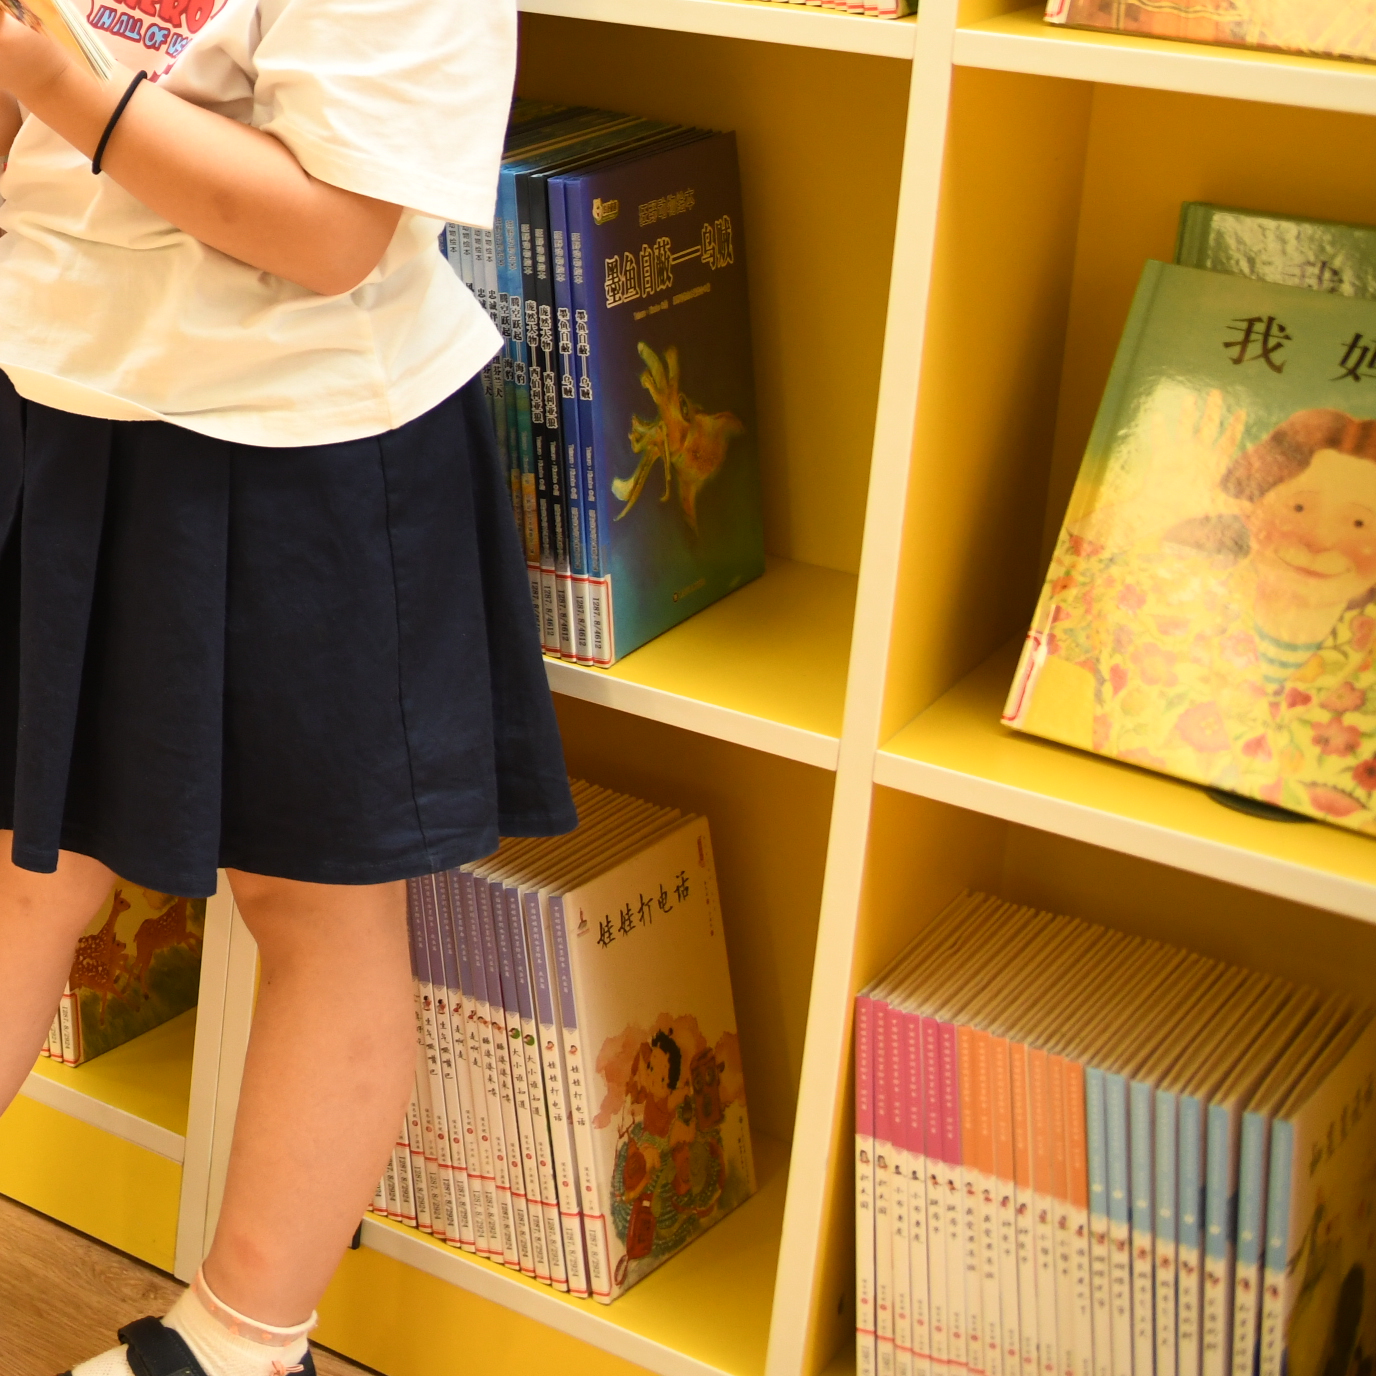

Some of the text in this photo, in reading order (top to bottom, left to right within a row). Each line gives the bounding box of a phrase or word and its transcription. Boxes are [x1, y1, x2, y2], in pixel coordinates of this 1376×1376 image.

[91, 5, 117, 31] IN
[144, 23, 170, 51] OF
[597, 870, 691, 951] 娃娃打电话
